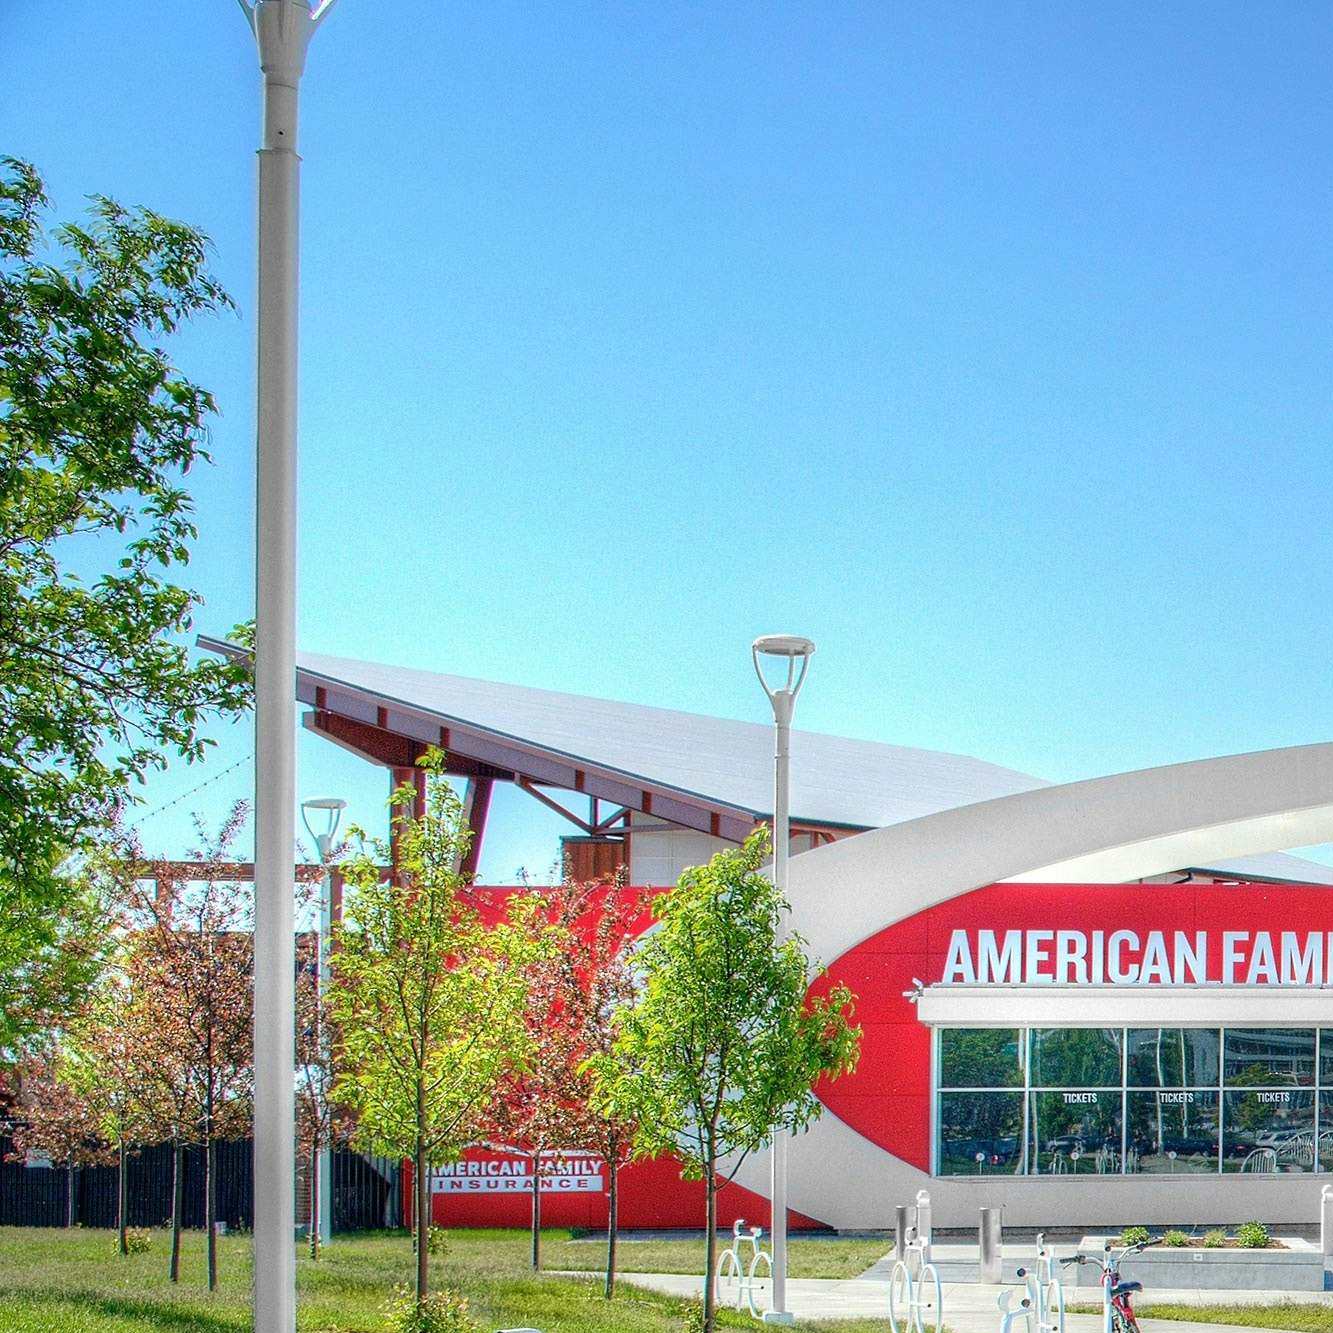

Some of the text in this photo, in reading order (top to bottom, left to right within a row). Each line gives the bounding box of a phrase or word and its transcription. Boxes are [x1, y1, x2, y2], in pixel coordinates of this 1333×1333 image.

[943, 929, 1207, 984] AMERICAN
[1063, 1092, 1098, 1104] TICKETS
[1160, 1092, 1194, 1103] TICKETS
[1257, 1092, 1290, 1103] TICKETS
[439, 1179, 588, 1189] INSURANCE
